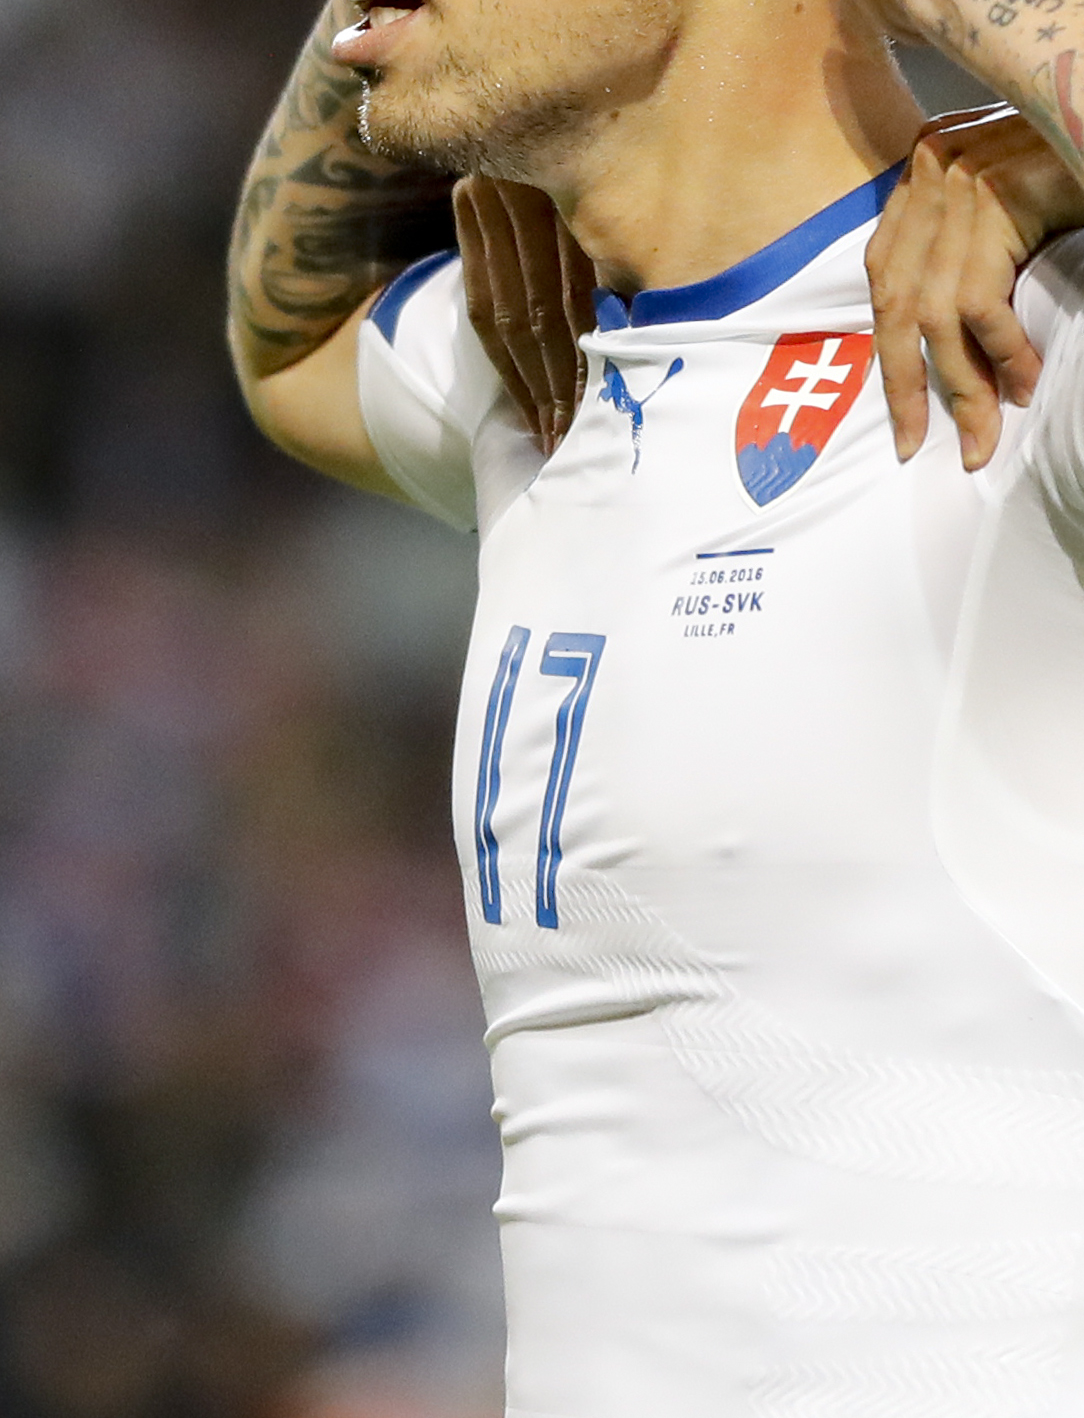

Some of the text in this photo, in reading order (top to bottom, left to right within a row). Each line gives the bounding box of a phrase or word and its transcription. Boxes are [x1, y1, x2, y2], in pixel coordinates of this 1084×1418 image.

[690, 567, 763, 585] 15.06.2016
[671, 591, 764, 616] RUS-SVK
[684, 623, 735, 638] LILLE,FR
[475, 625, 607, 929] 17
